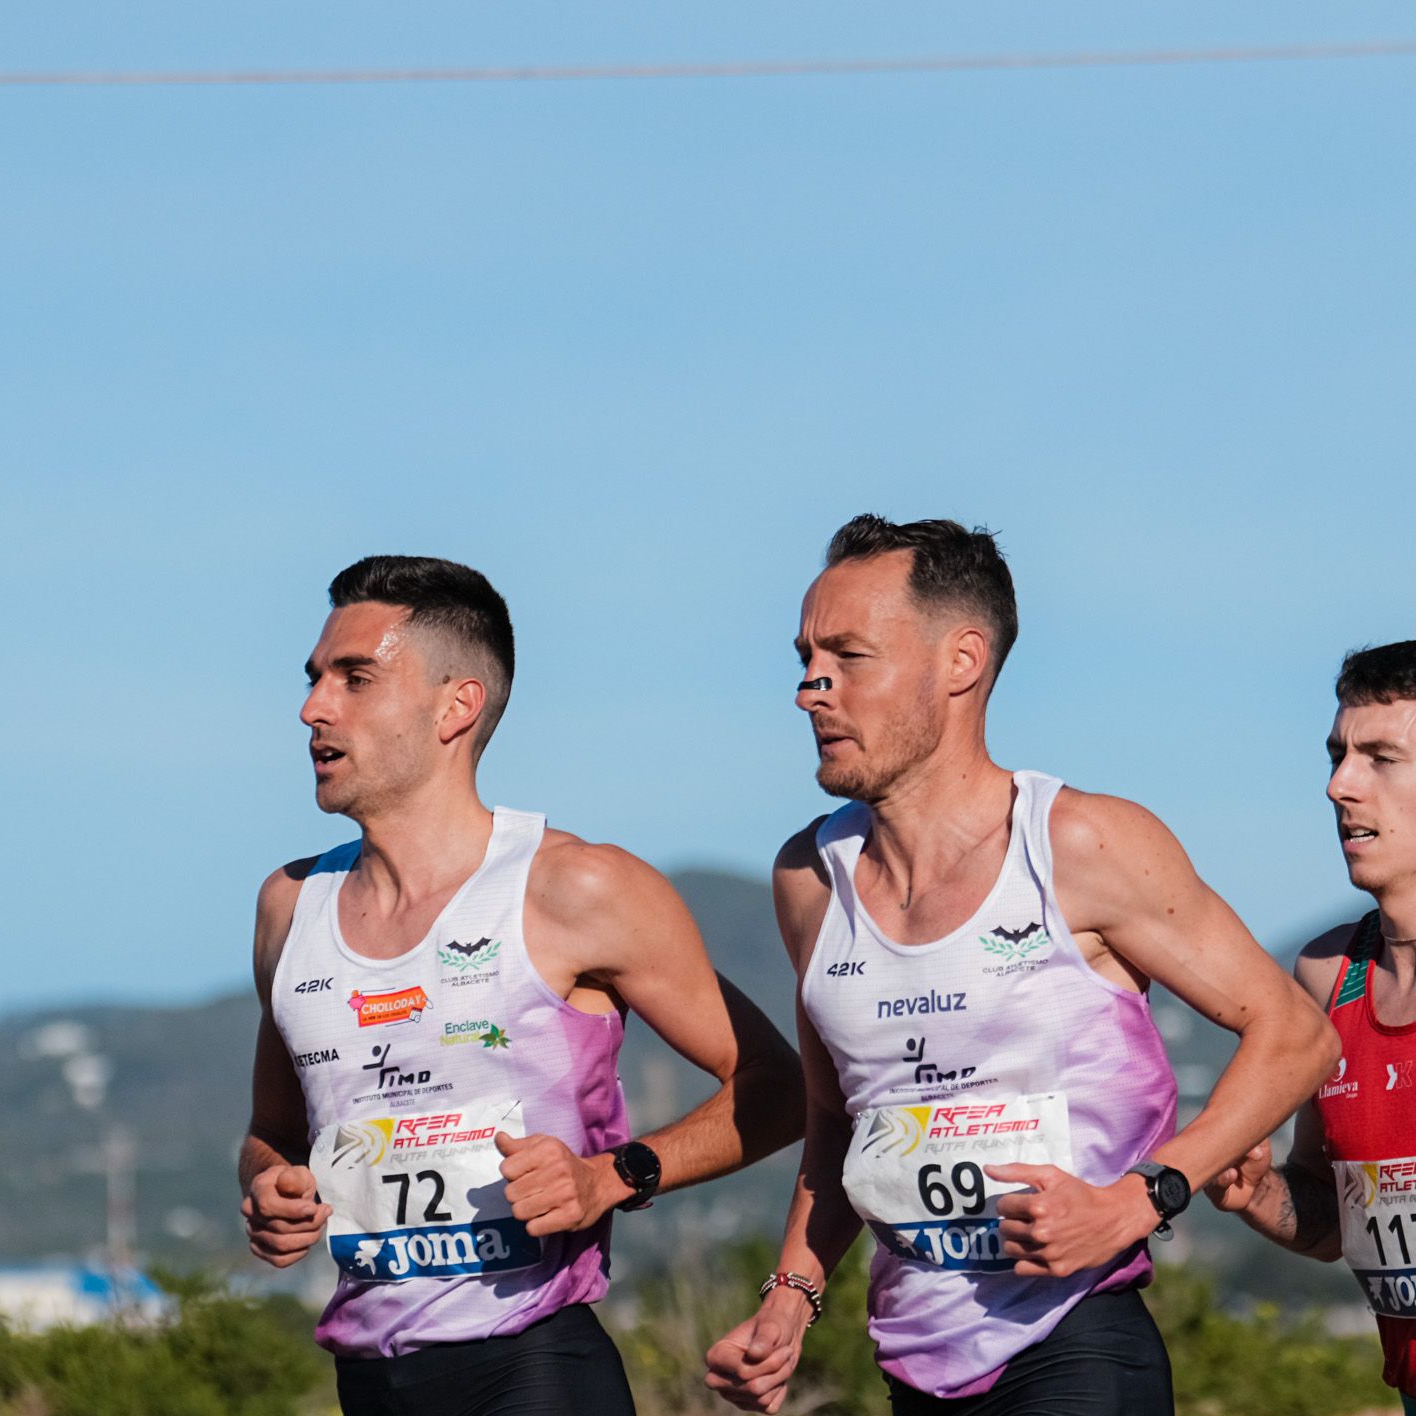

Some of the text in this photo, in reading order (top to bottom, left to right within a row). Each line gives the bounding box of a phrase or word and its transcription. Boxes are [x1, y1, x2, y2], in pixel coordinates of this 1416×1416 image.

[826, 961, 867, 977] 42K
[294, 977, 334, 994] 42K
[361, 994, 422, 1015] CHOLLODAY
[877, 989, 967, 1018] nevaluz
[445, 1019, 489, 1035] Enclave
[381, 1089, 413, 1099] MUNICIPAL
[422, 1083, 454, 1094] DEPORTES
[396, 1113, 462, 1135] RFEA
[934, 1103, 1006, 1125] RFEA
[929, 1118, 1040, 1138] ATLETISMO
[393, 1127, 496, 1150] ATLETISMO
[925, 1134, 1046, 1154] RUTA RUNNING
[390, 1150, 427, 1165] RUTA
[381, 1169, 453, 1225] 72
[918, 1161, 986, 1217] 69
[1380, 1194, 1407, 1207] RUTA
[924, 1225, 1006, 1266] Jom
